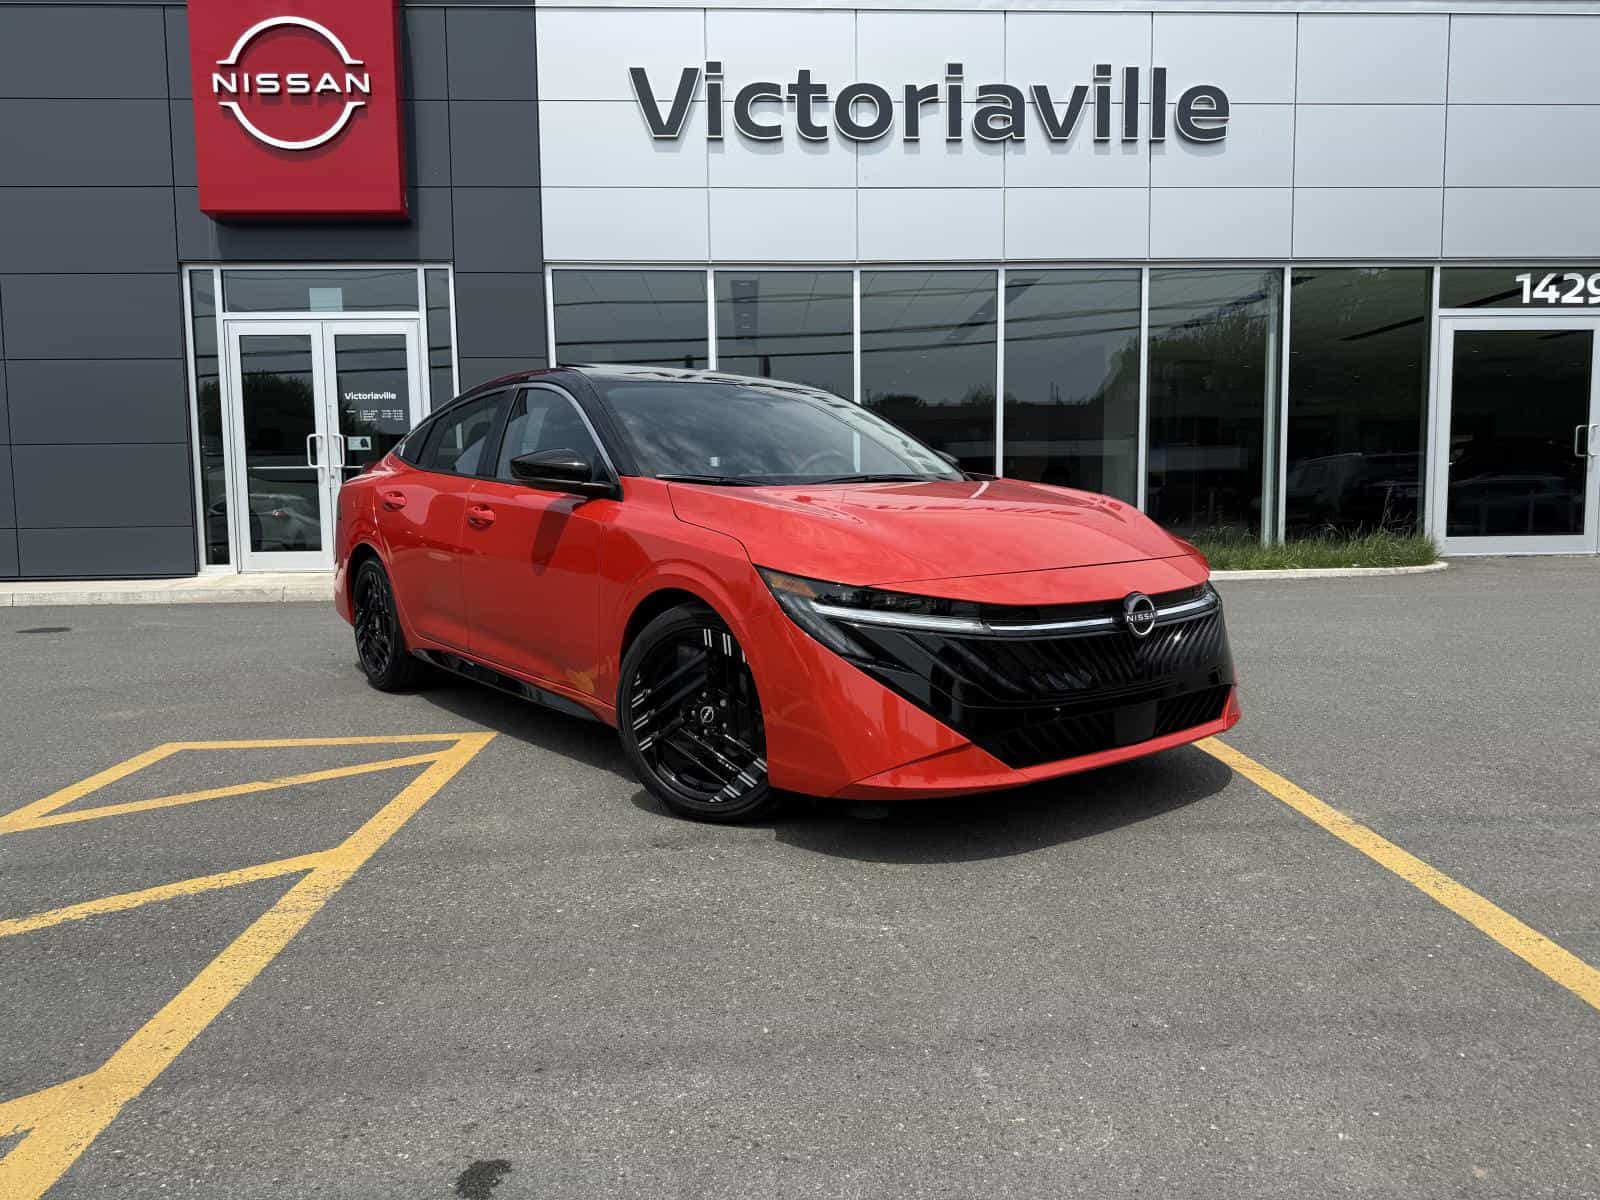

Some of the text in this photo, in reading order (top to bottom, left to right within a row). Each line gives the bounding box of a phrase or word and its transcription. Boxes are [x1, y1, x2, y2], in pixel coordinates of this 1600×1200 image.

[212, 72, 371, 94] NISSAN
[628, 61, 1231, 144] Victoriaville
[1515, 272, 1600, 304] 1429
[344, 391, 397, 401] Victoriaville
[1126, 612, 1155, 623] NISSA
